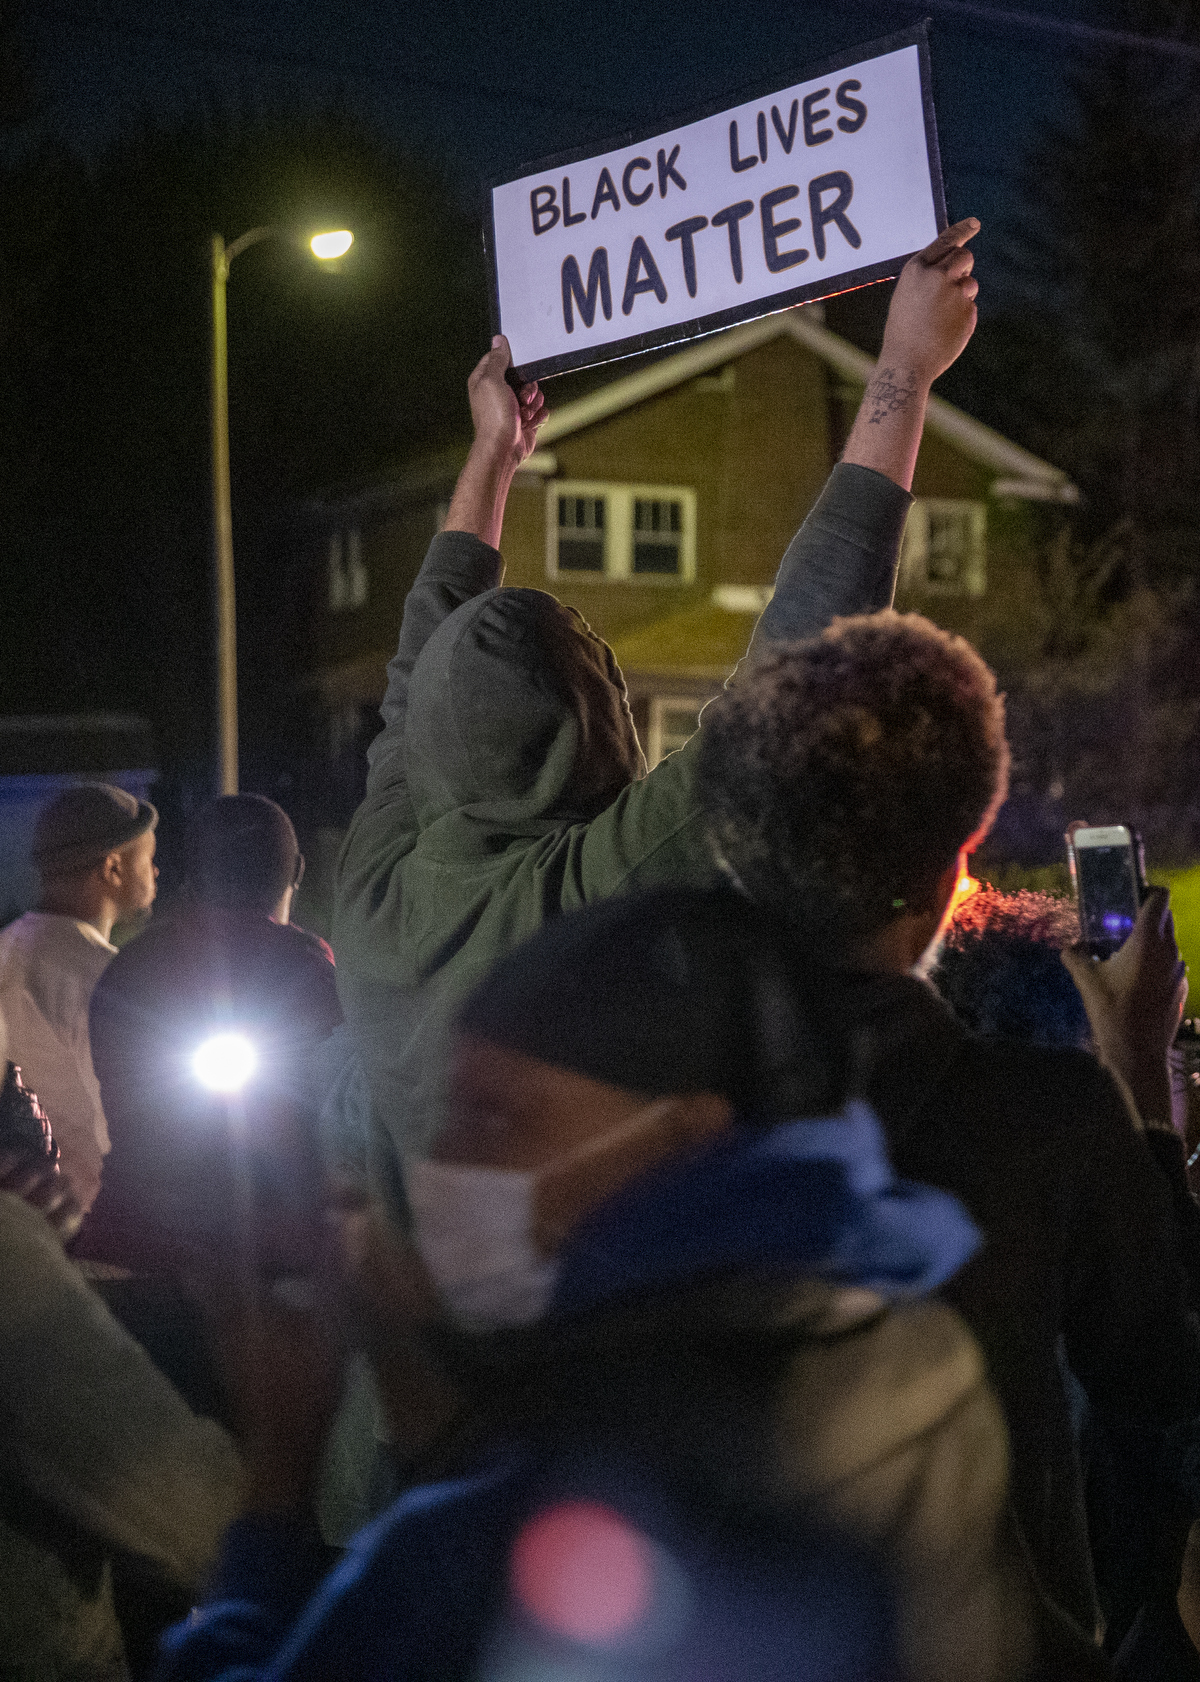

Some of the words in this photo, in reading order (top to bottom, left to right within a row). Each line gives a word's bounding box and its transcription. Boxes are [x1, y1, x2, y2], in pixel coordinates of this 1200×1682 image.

[529, 143, 688, 236] BLACK
[728, 78, 868, 174] LIVES
[560, 170, 862, 334] MATTER
